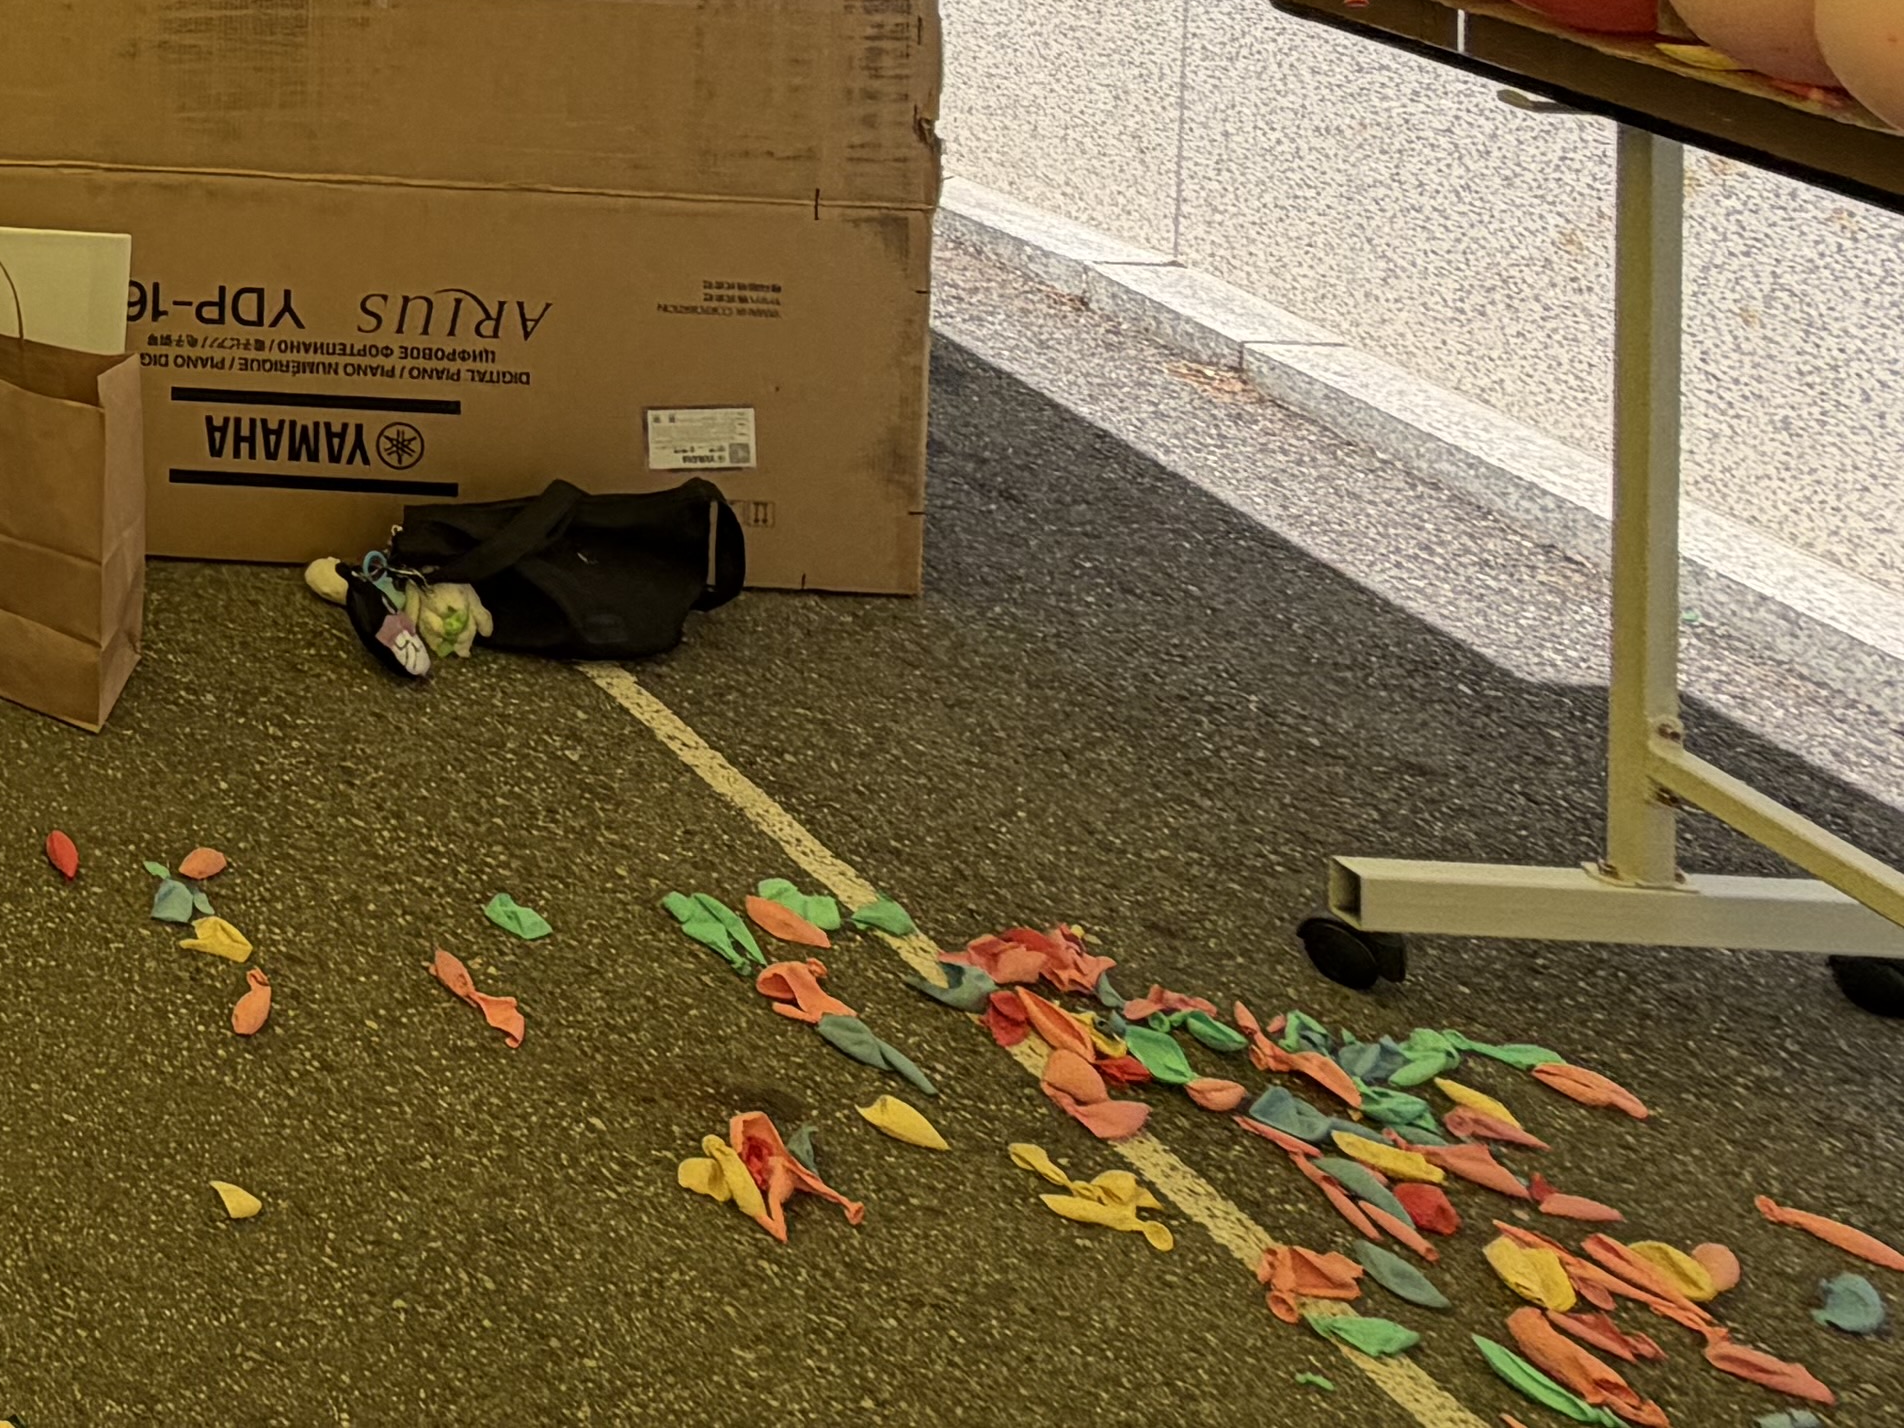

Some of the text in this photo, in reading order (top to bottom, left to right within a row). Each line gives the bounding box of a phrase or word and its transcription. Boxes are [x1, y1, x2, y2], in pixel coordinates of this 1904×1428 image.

[356, 288, 553, 342] ARIUS
[278, 339, 394, 359] ФОРТЕПИАНО
[398, 345, 496, 364] ЦИФРОВОЕ
[173, 355, 225, 370] PIANO
[237, 356, 339, 378] NUMÉRIQUE
[343, 362, 395, 378] PIANO
[408, 366, 461, 382] PIANO
[466, 369, 531, 385] DIGITAL
[204, 415, 371, 467] YAMAHA
